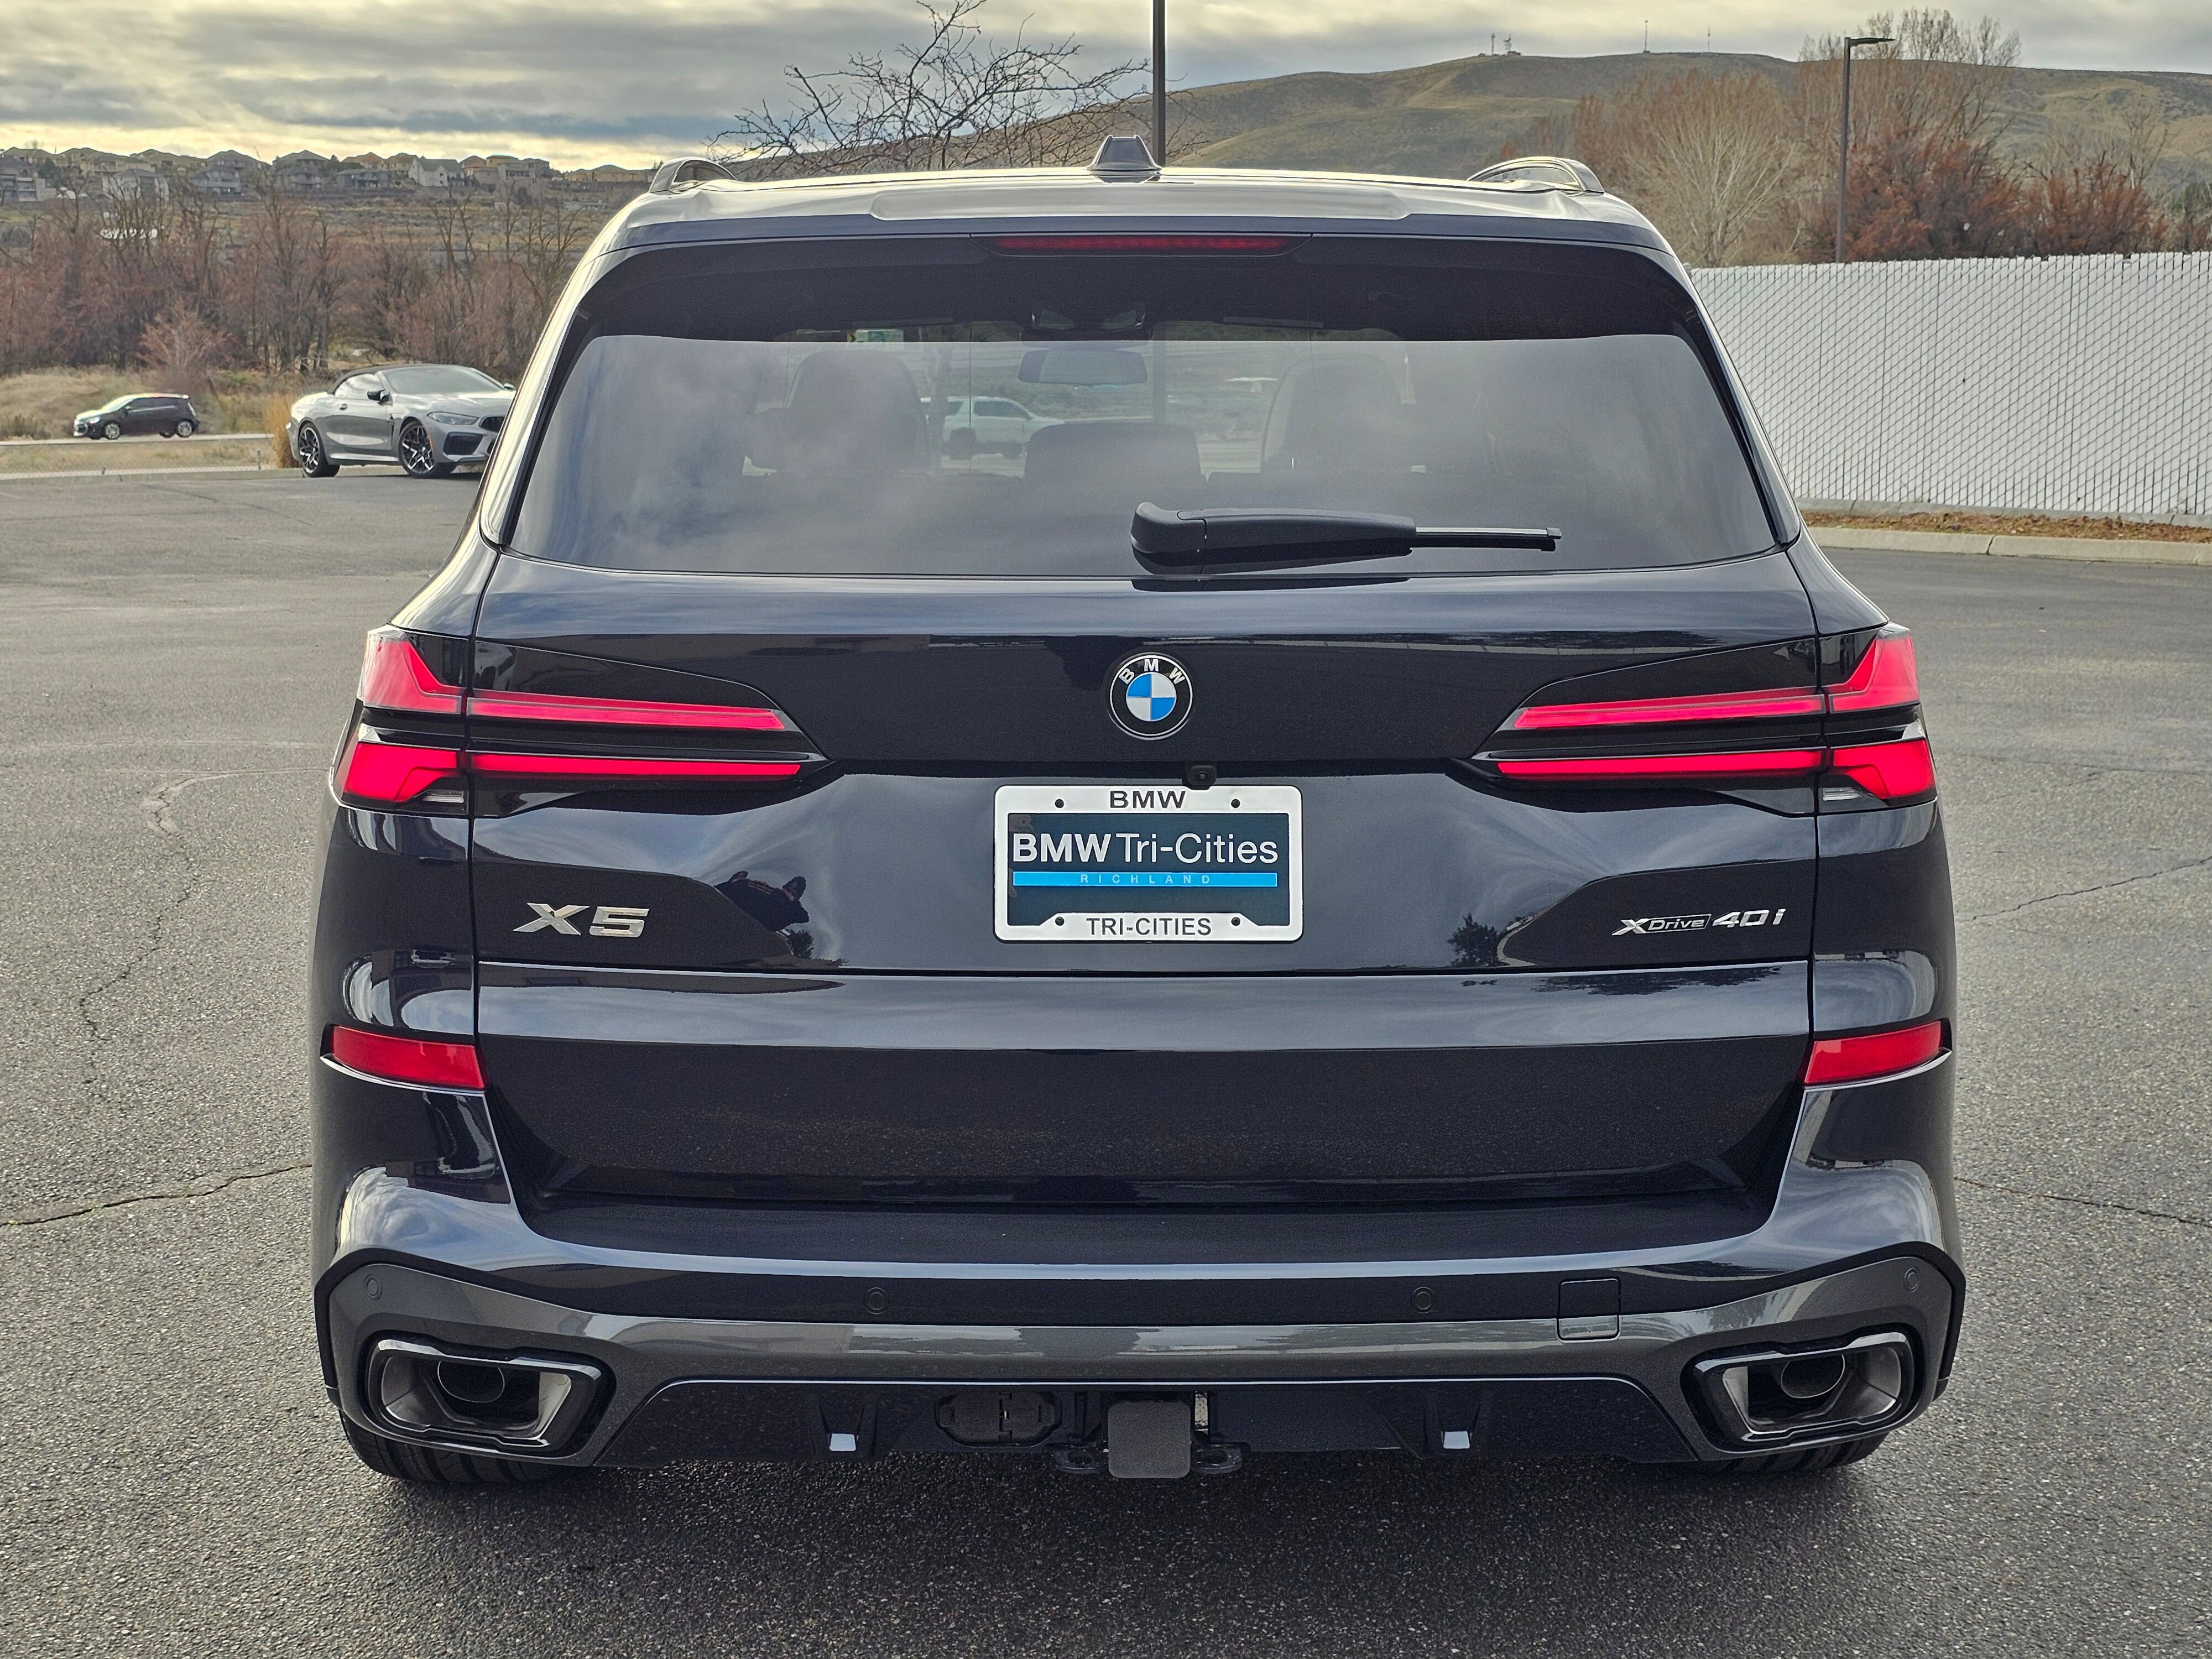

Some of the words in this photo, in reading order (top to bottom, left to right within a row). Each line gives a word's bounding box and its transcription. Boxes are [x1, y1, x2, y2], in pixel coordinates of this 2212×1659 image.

[1118, 659, 1186, 685] BMW
[1109, 791, 1186, 808] BMW
[1013, 833, 1112, 862] BMW
[1115, 833, 1279, 863] Tri-Cities
[1080, 874, 1211, 884] RICHLAND
[513, 902, 650, 938] X5
[1086, 918, 1212, 936] TRI-CITIES
